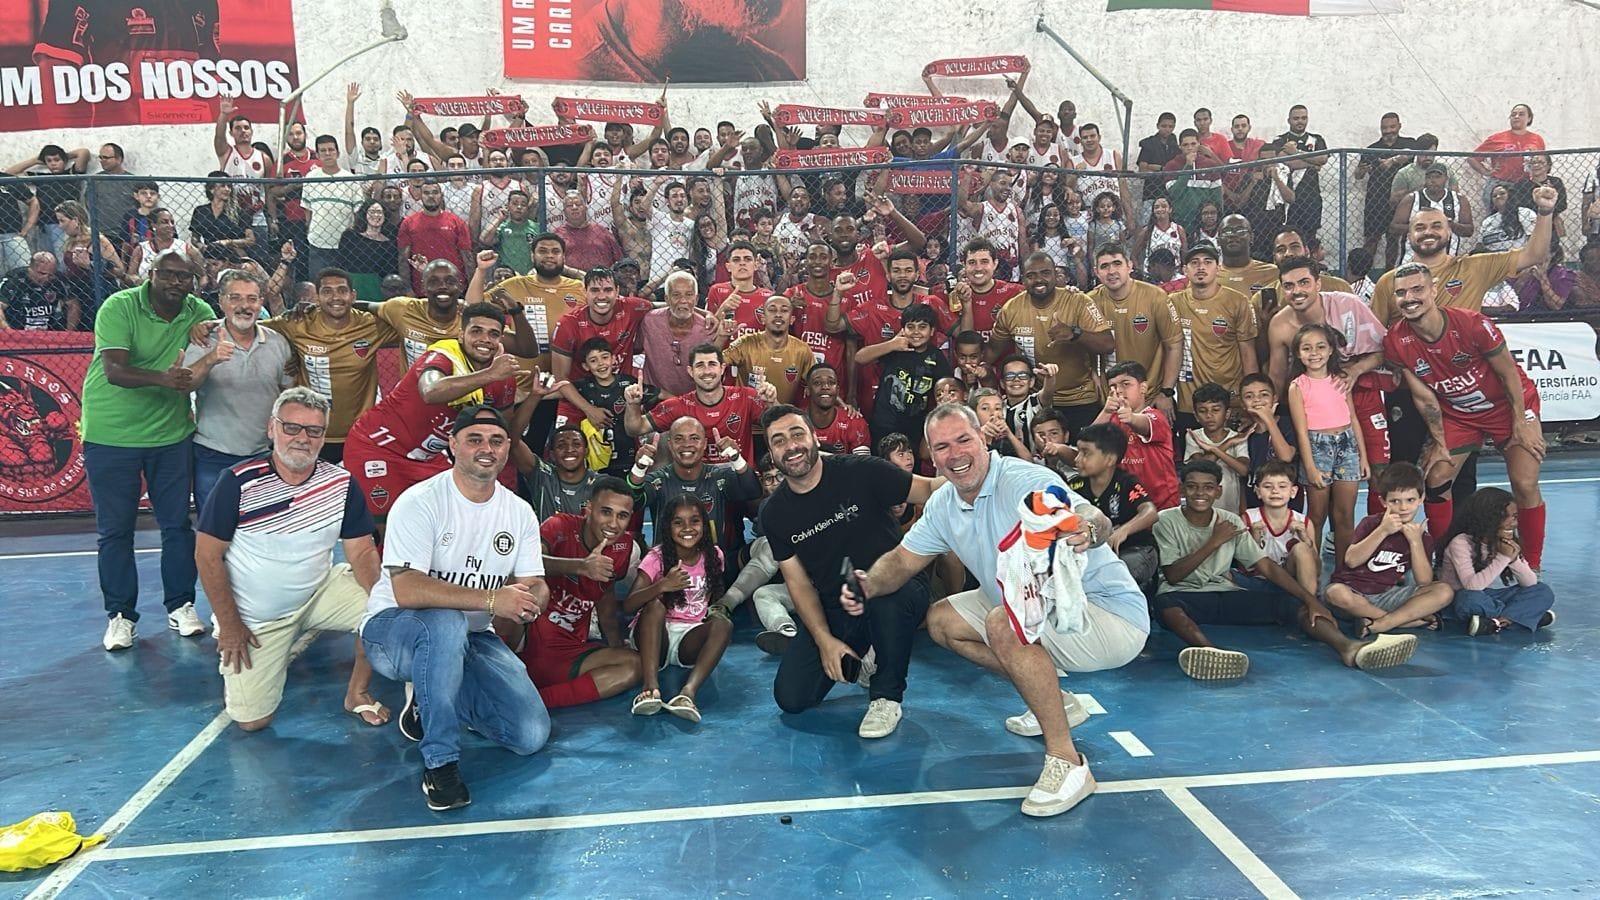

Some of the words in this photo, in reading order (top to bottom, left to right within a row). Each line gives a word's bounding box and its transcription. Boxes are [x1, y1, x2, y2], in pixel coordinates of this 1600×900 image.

[549, 0, 572, 49] CAR
[0, 66, 43, 106] M
[52, 62, 131, 105] DOS
[141, 59, 292, 100] NOSSOS
[25, 304, 53, 317] YESU
[305, 344, 328, 354] YESU
[1428, 369, 1477, 394] YESU
[1534, 375, 1598, 389] VERSITÁRIO
[1540, 390, 1569, 402] ência
[1571, 389, 1592, 400] FAA
[791, 528, 815, 544] Calvin
[814, 518, 834, 533] Klein
[834, 504, 859, 522] Jens
[465, 555, 483, 572] Fly
[1374, 550, 1404, 564] NIKE
